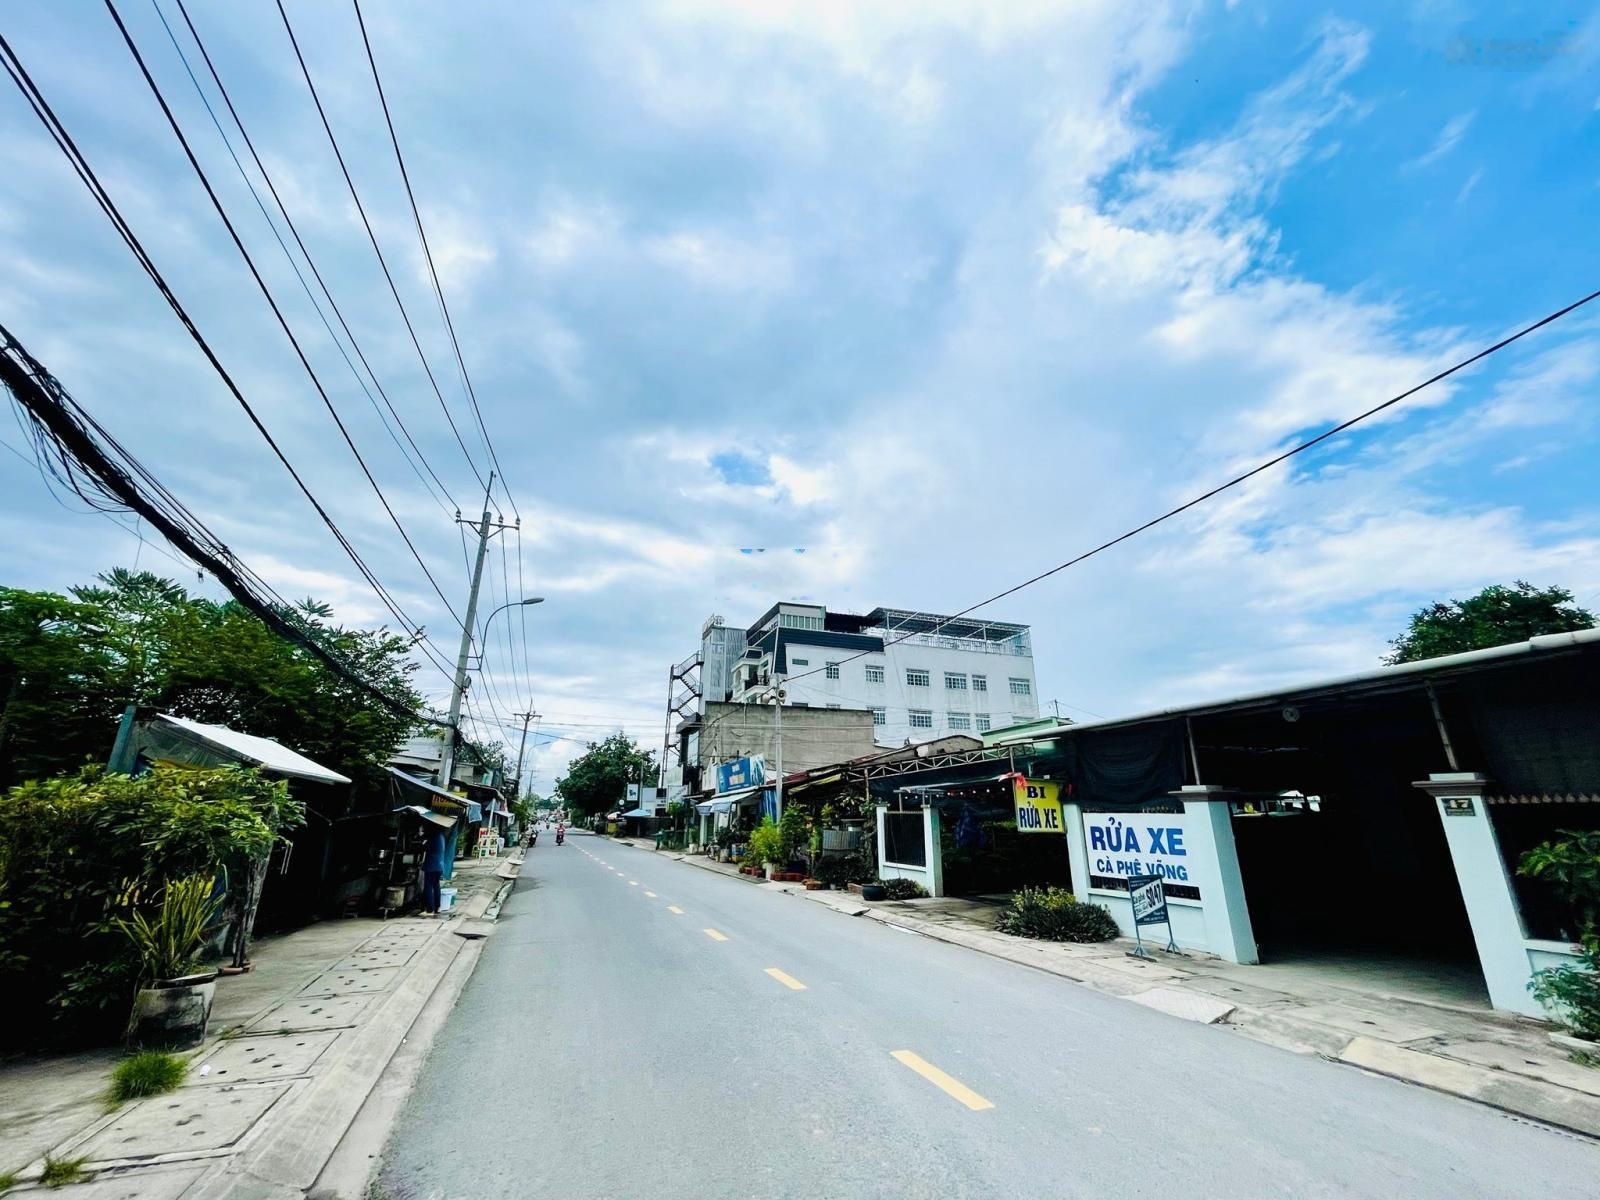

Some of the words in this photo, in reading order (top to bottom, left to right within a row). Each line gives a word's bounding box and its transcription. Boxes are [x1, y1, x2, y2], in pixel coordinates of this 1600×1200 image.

[1027, 786, 1047, 799] BI
[1019, 801, 1042, 828] RỬA
[1043, 808, 1059, 829] XE
[1090, 817, 1141, 853] RỬA
[1146, 827, 1187, 856] XE
[1097, 855, 1114, 874] CÀ
[1116, 859, 1143, 876] PHÊ
